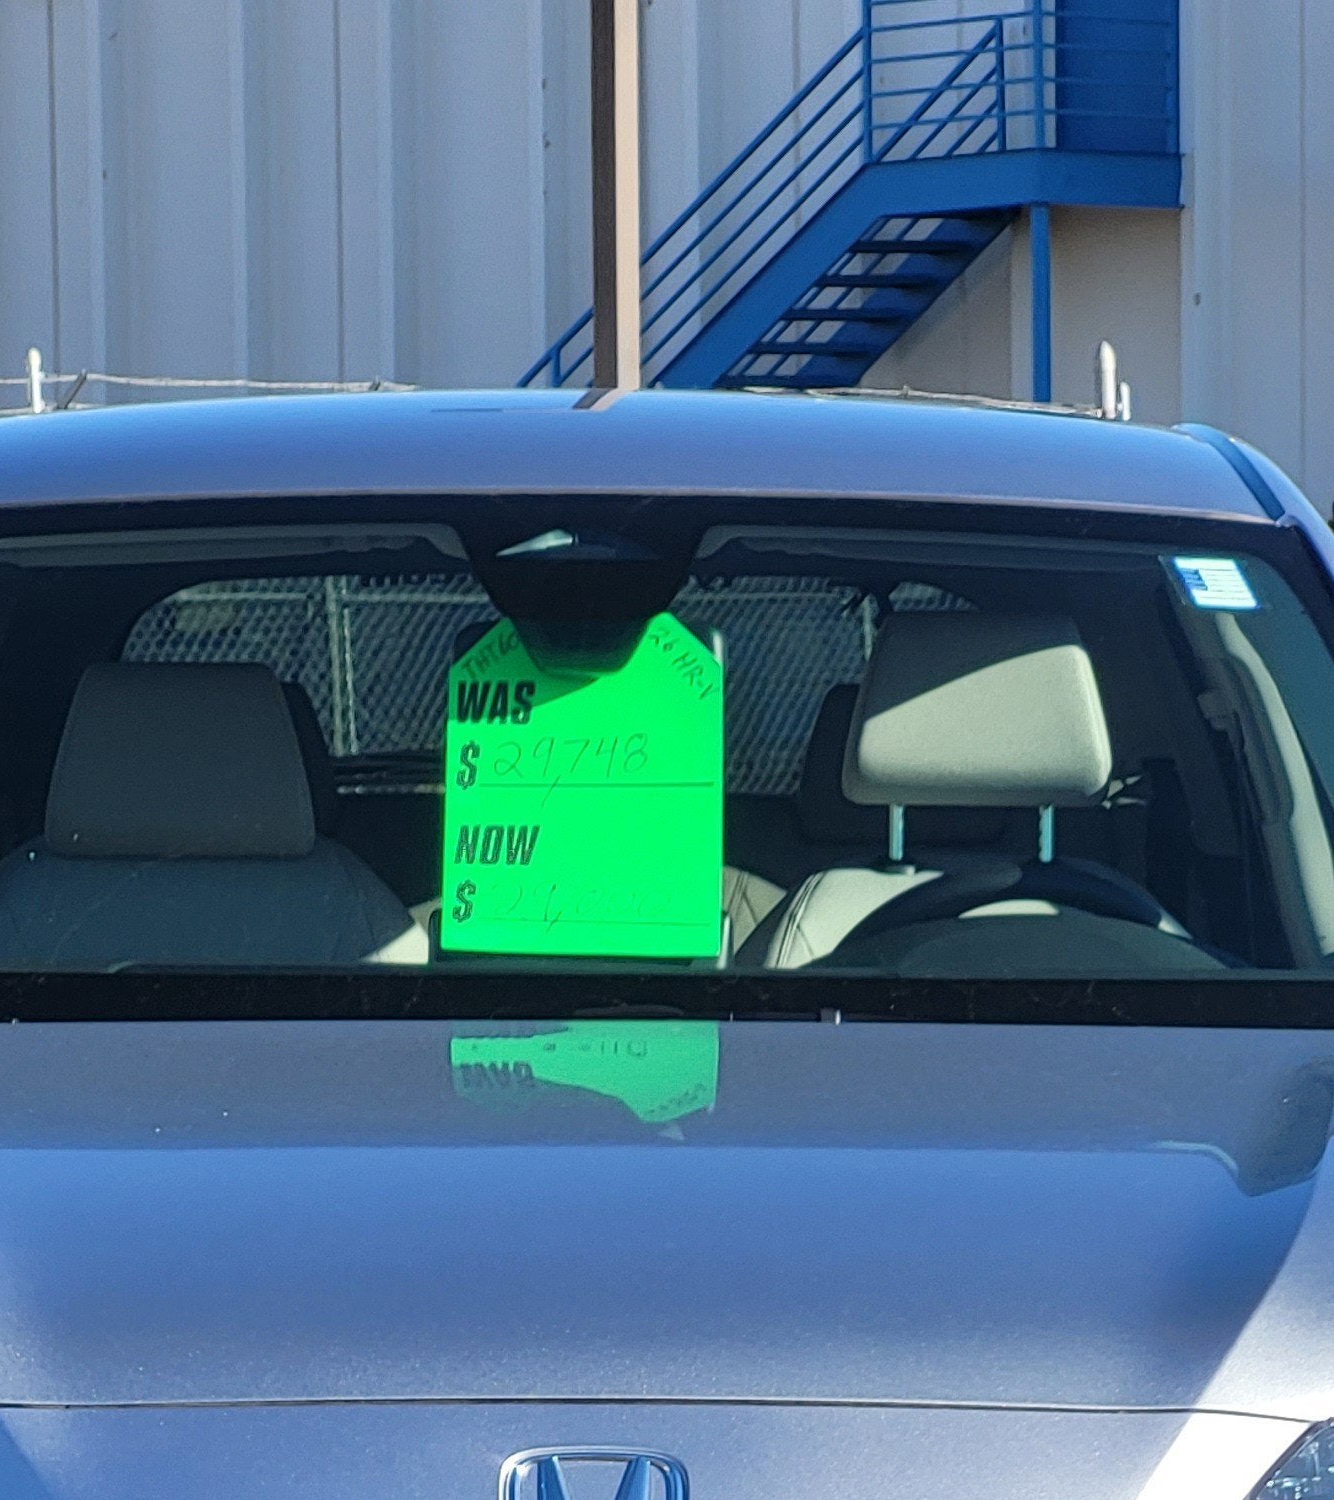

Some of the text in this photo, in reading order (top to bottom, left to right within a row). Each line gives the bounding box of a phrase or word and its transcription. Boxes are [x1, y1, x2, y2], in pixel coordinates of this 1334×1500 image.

[455, 679, 536, 725] WAS
[456, 733, 649, 810] $ 29,748
[454, 825, 541, 866] NOW
[452, 879, 477, 923] $
